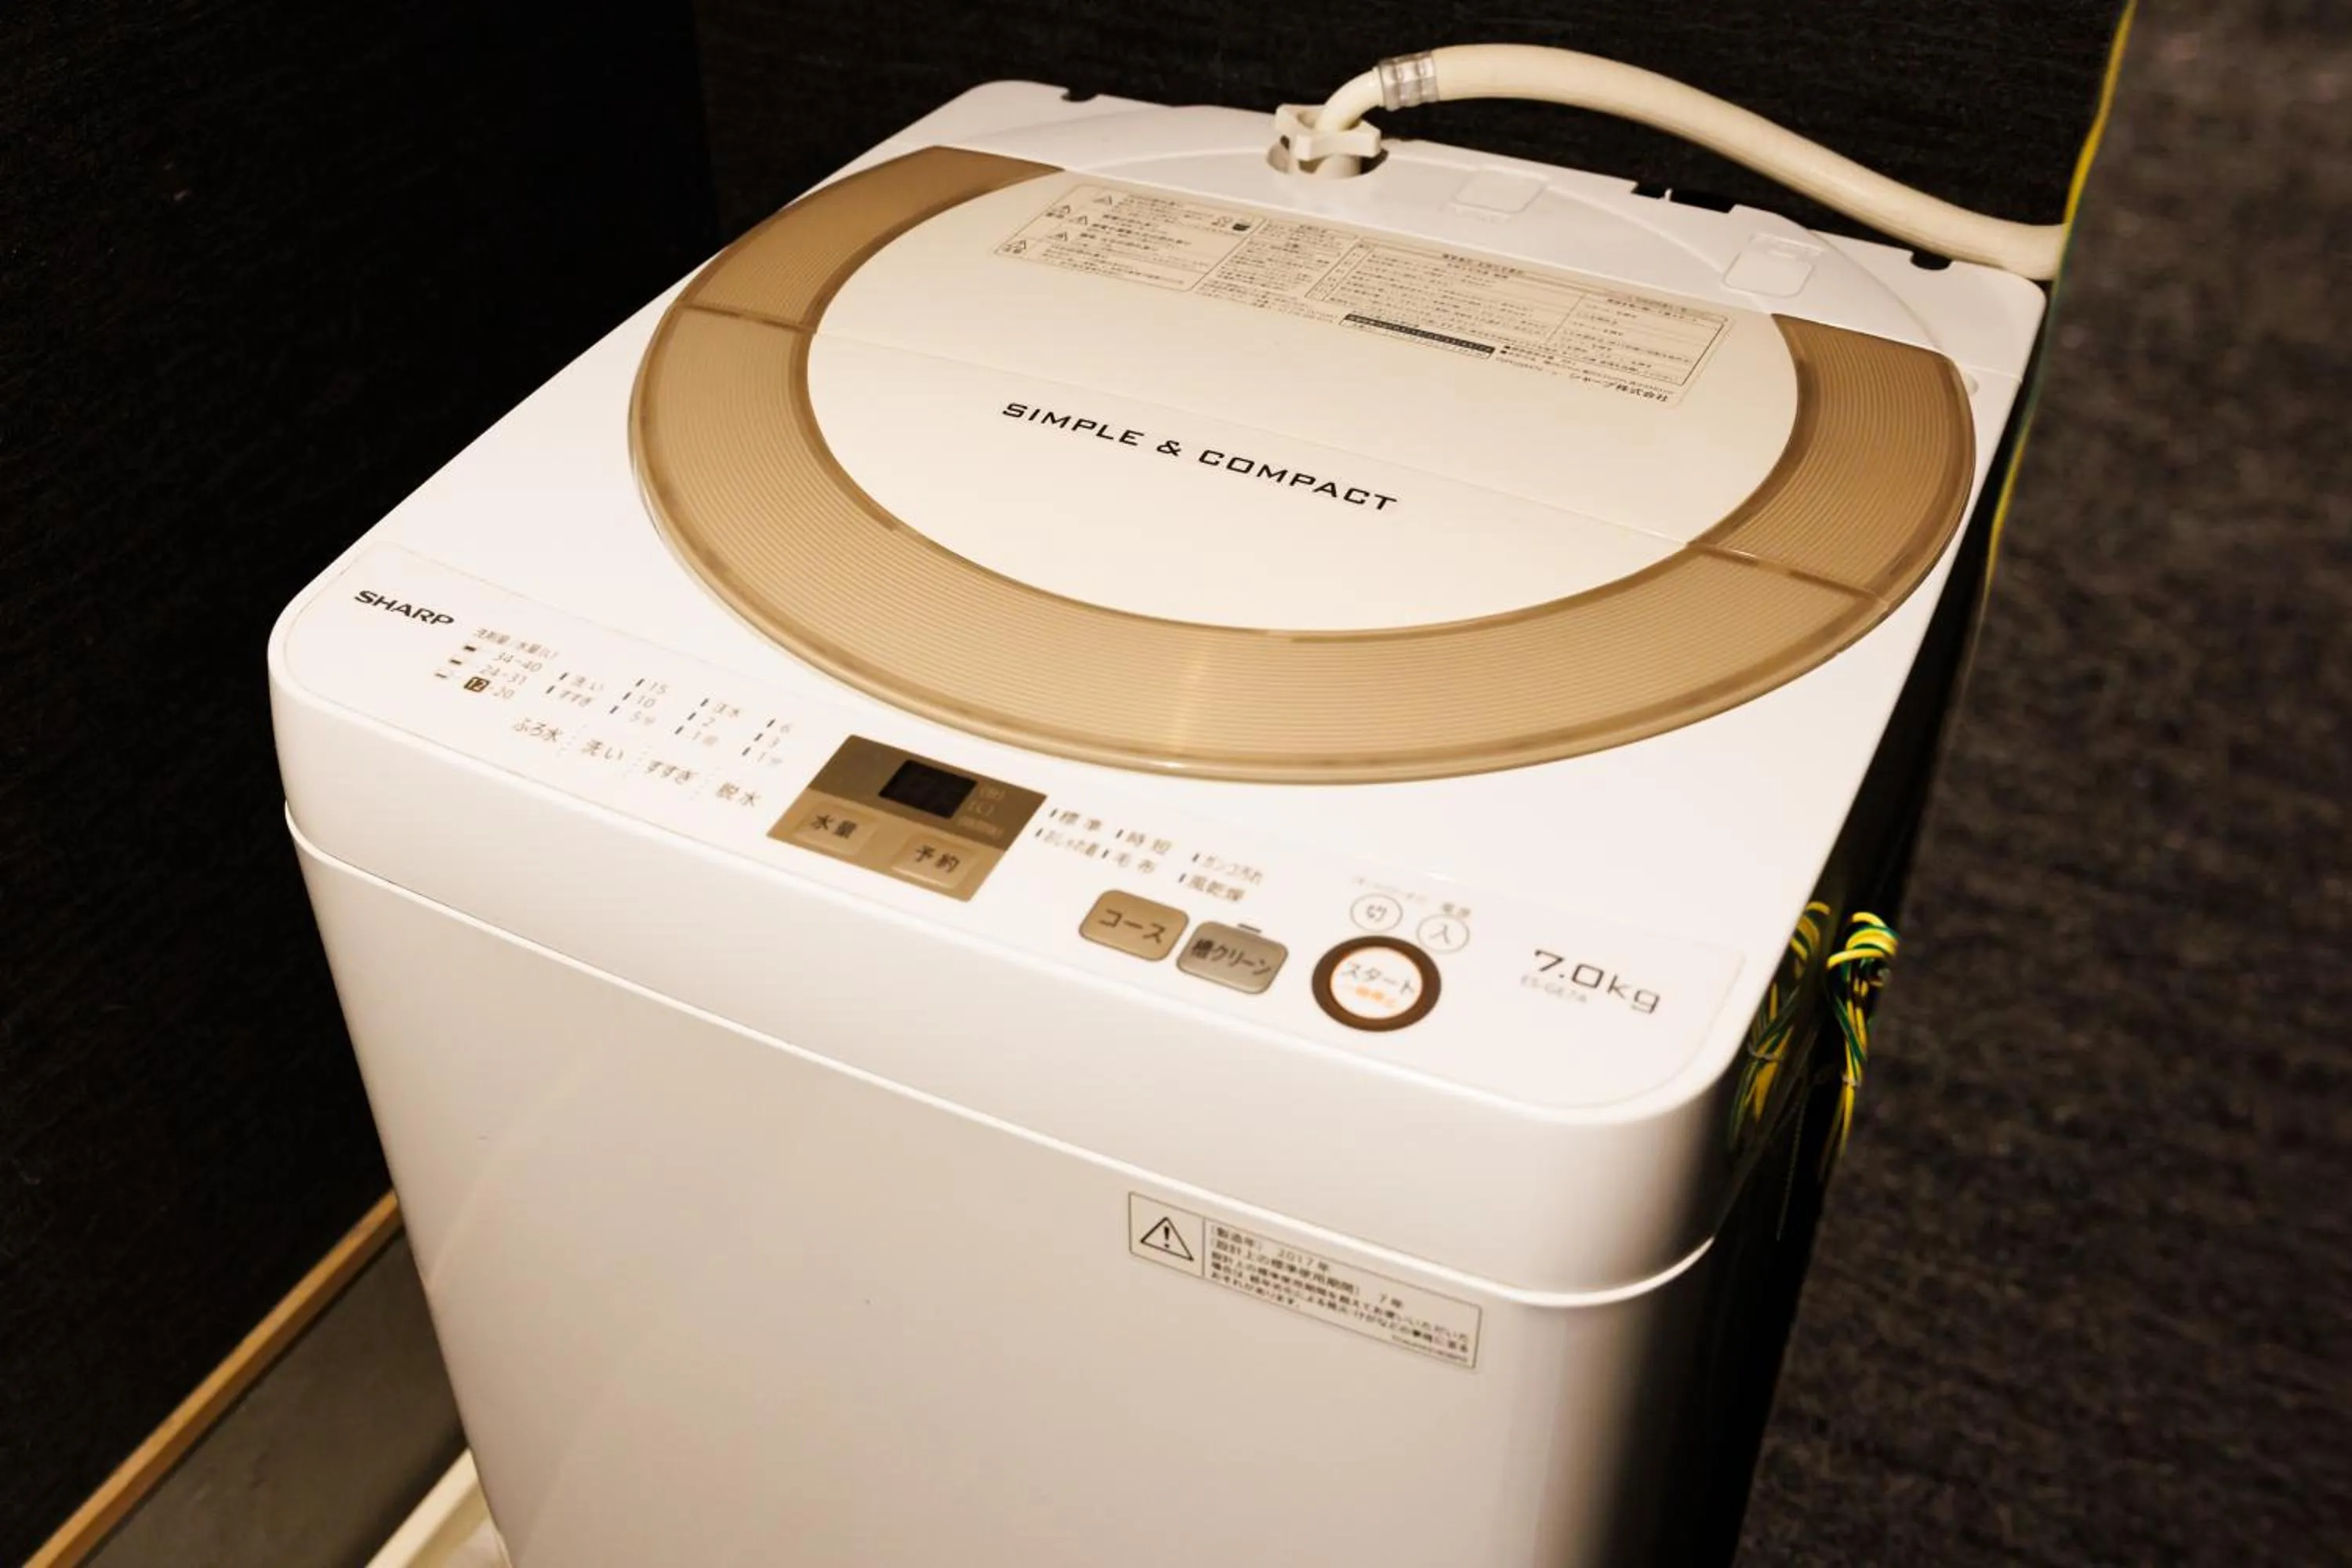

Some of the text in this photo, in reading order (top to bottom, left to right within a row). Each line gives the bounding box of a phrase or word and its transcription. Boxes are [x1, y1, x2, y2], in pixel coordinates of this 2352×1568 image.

[1002, 402, 1398, 511] SIMPLE & COMPACT
[354, 590, 455, 627] SHARP
[636, 694, 657, 710] 10
[649, 681, 670, 695] 15
[511, 717, 563, 743] ふろ水
[579, 738, 626, 761] 洗い
[644, 760, 699, 786] すすぎ
[714, 781, 762, 808] 脱水
[809, 811, 859, 840] 水量
[913, 844, 961, 874] 予約
[1097, 908, 1167, 944] コース
[1366, 904, 1388, 924] 切
[1189, 938, 1273, 977] 槽クリーン
[1341, 960, 1416, 995] スタート
[1533, 948, 1662, 1015] 7.0kg
